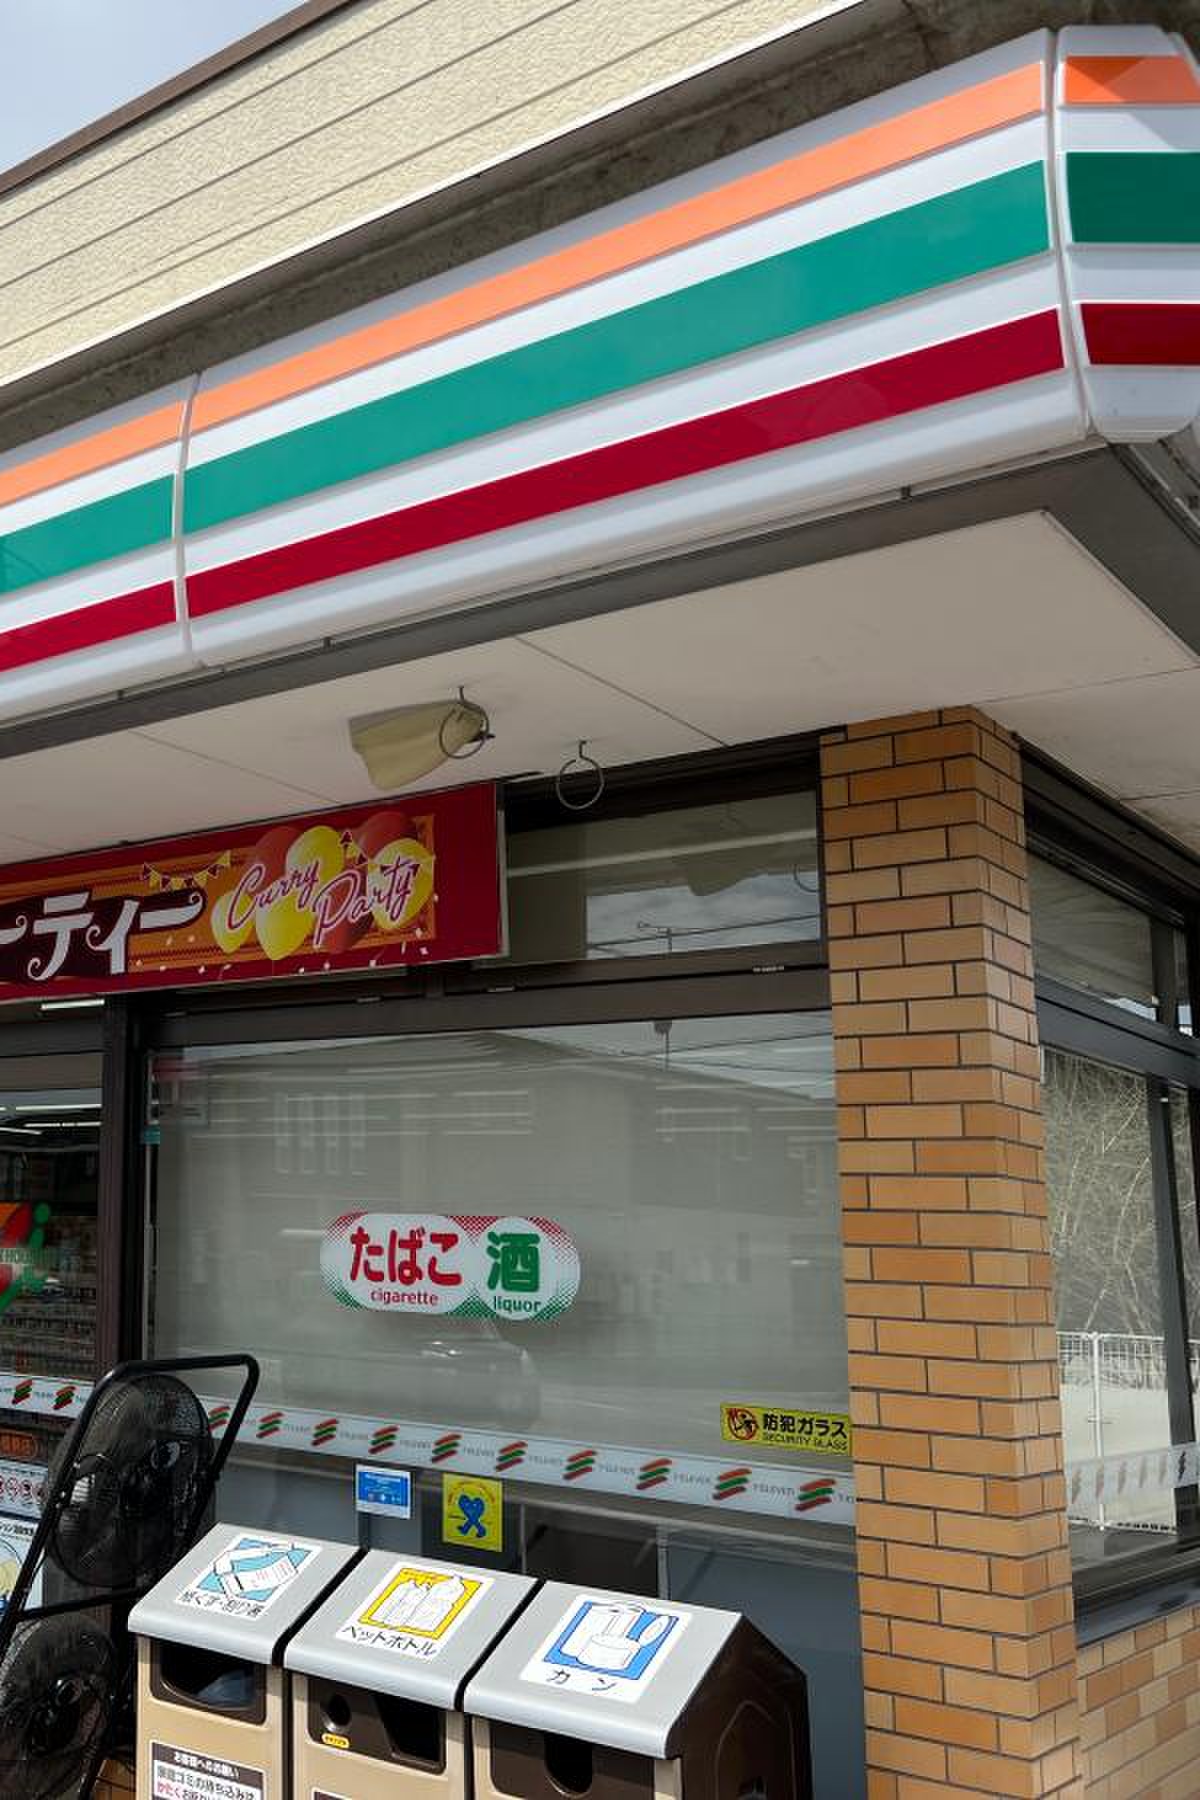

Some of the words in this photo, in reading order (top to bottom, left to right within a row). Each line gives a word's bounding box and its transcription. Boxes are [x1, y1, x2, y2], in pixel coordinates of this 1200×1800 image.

[227, 860, 320, 931] Curry
[313, 859, 418, 950] Party
[351, 1226, 463, 1286] たばこ
[486, 1231, 541, 1293] 酒
[370, 1289, 439, 1306] cigarette
[494, 1295, 542, 1314] liquor
[762, 1413, 847, 1439] 防犯ガラス
[763, 1432, 812, 1446] SECURITY
[814, 1438, 848, 1451] GLASS
[342, 1625, 438, 1657] ペットボトル
[548, 1668, 616, 1692] カン
